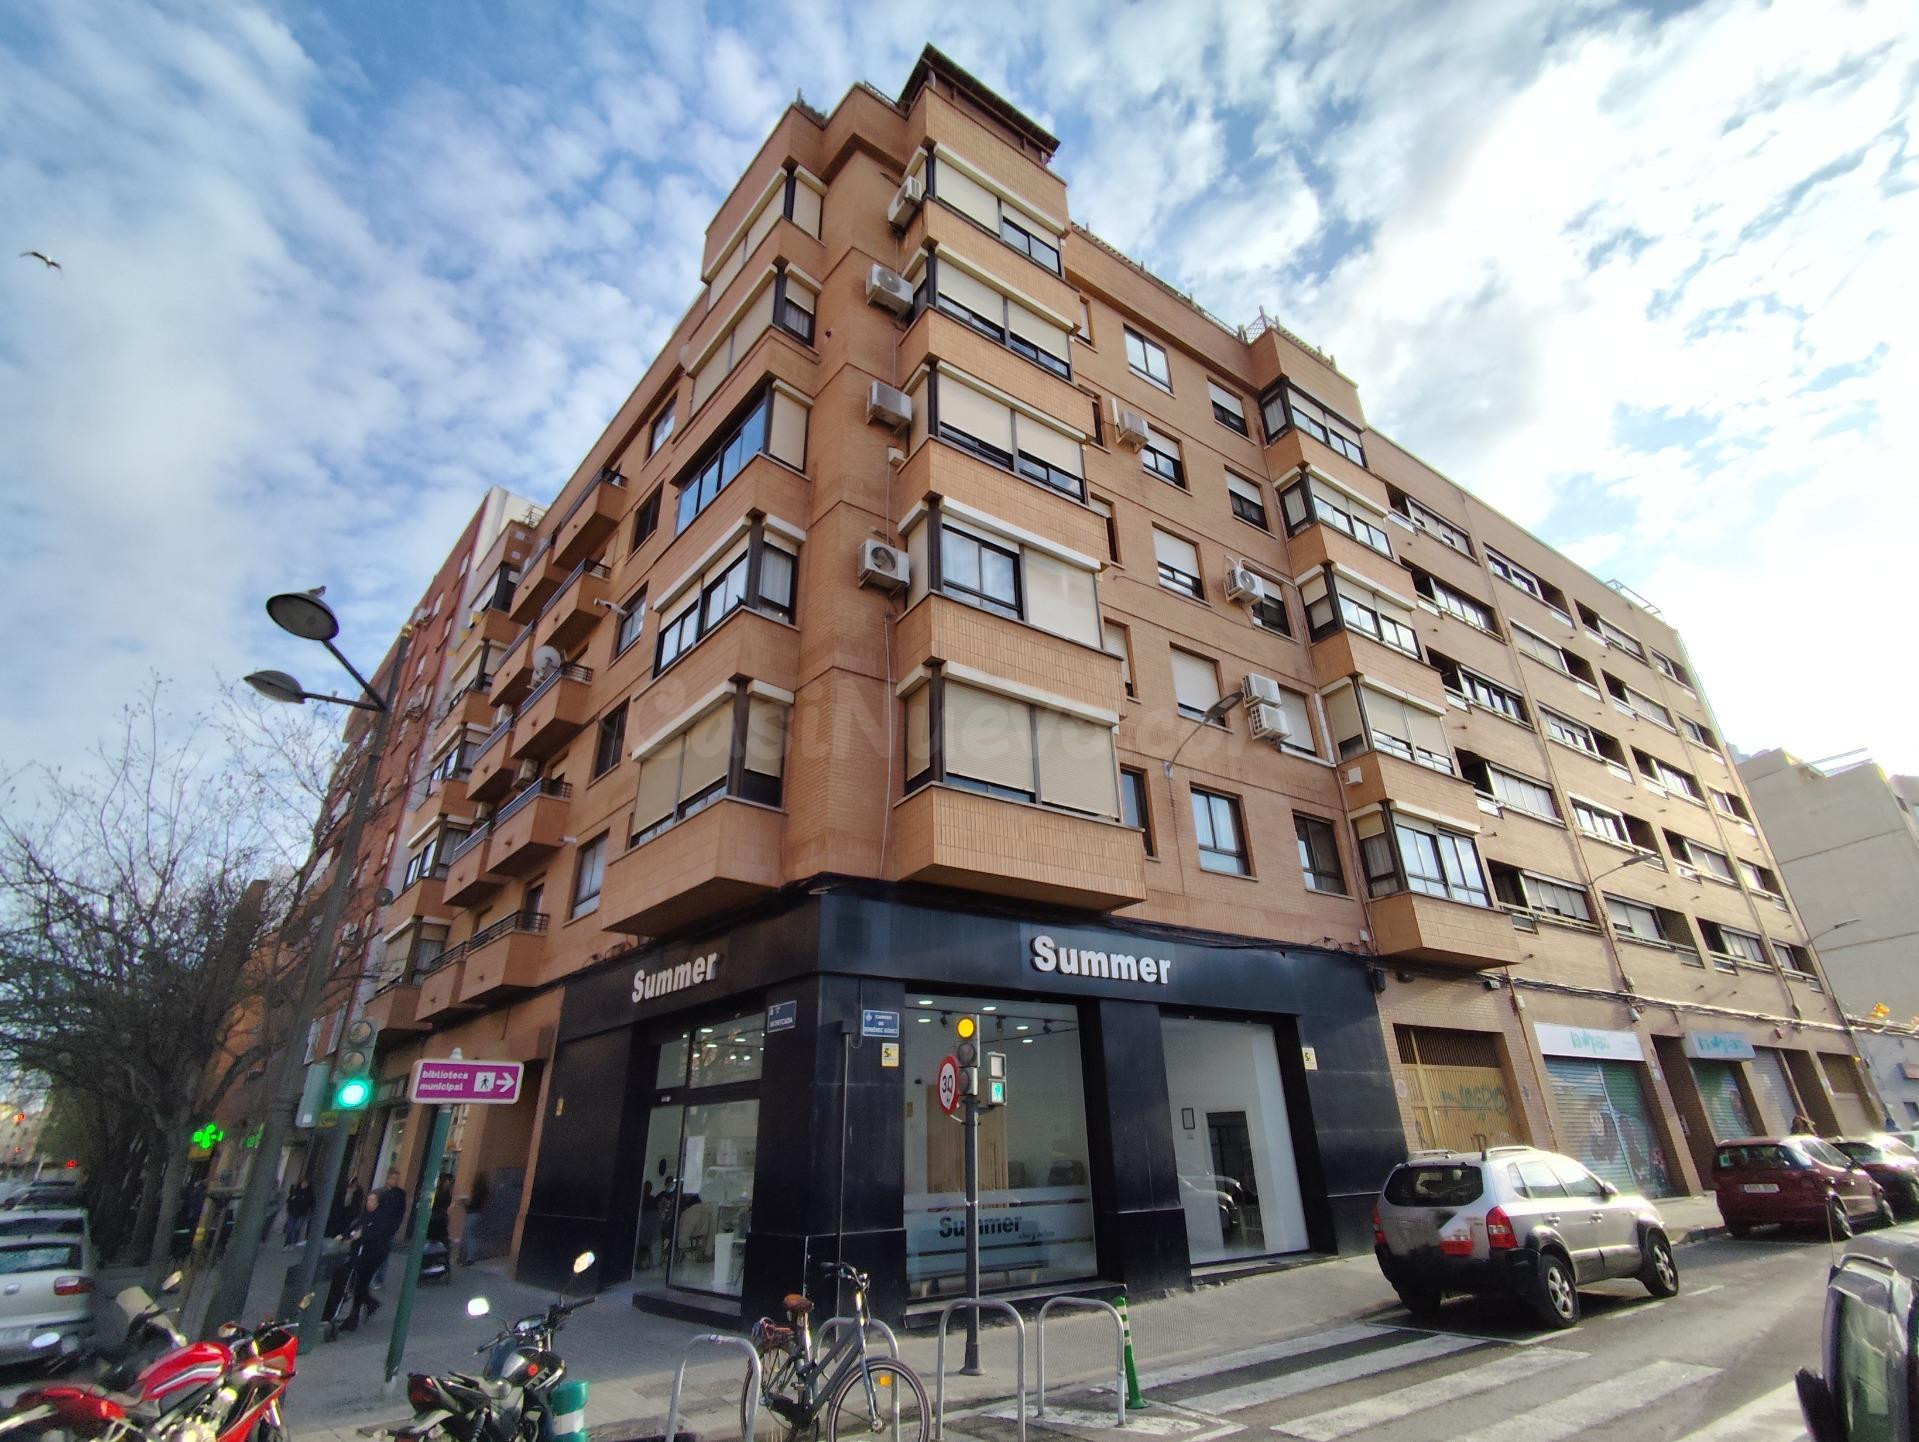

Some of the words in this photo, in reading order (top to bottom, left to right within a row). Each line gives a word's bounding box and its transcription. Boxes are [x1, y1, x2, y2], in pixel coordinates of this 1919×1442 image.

[1032, 934, 1171, 984] Summer
[631, 951, 718, 1003] Summer
[422, 1069, 469, 1080] biblioteca
[941, 1074, 954, 1093] 30
[419, 1082, 463, 1092] municipal
